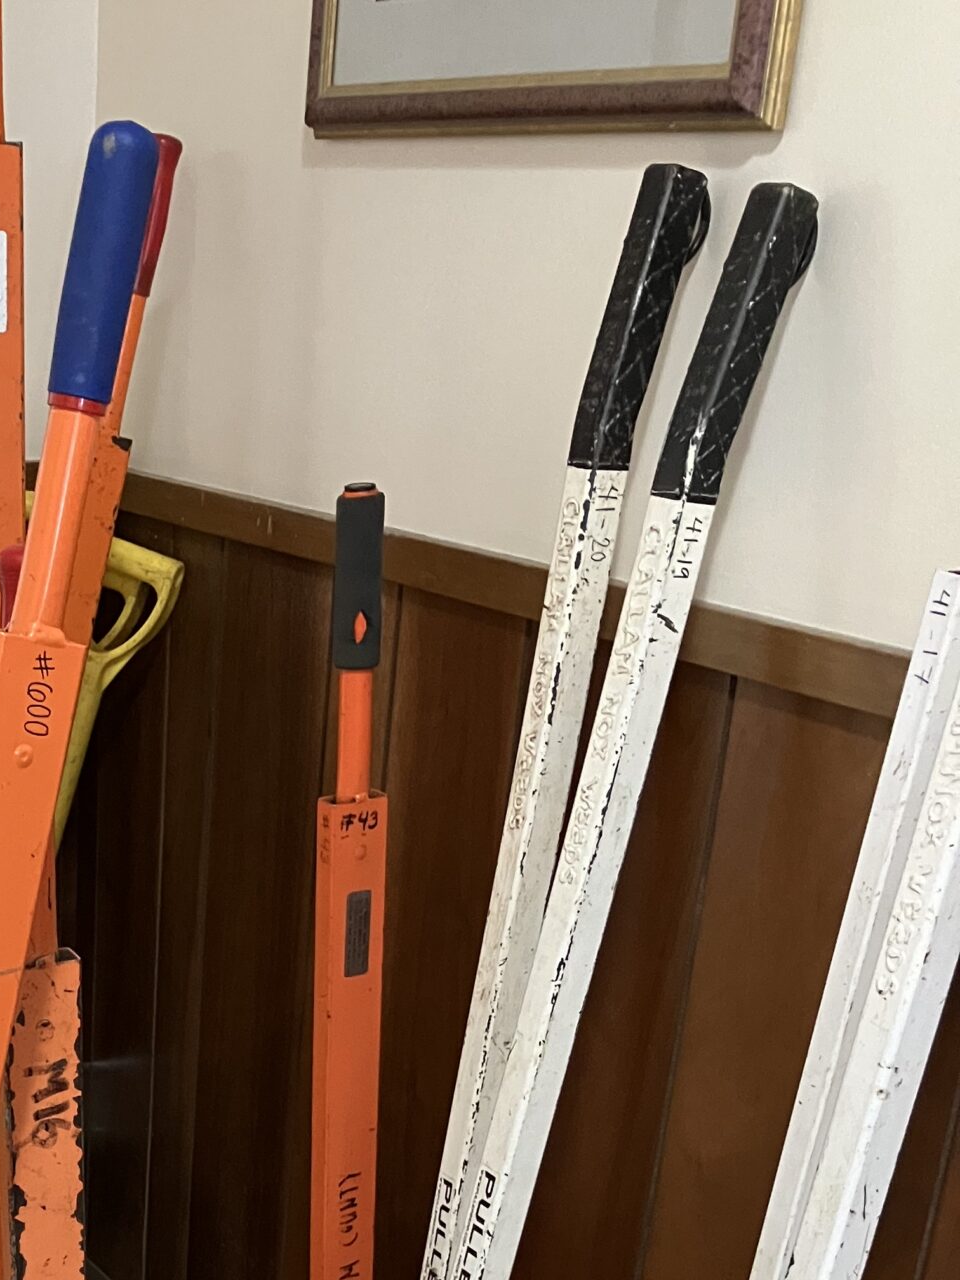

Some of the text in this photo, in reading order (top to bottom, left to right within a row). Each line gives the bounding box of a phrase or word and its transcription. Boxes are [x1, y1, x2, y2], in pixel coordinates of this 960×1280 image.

[590, 486, 618, 562] 41-20
[672, 516, 704, 580] 41-19
[914, 588, 951, 685] 41-17
[24, 651, 56, 736] #600
